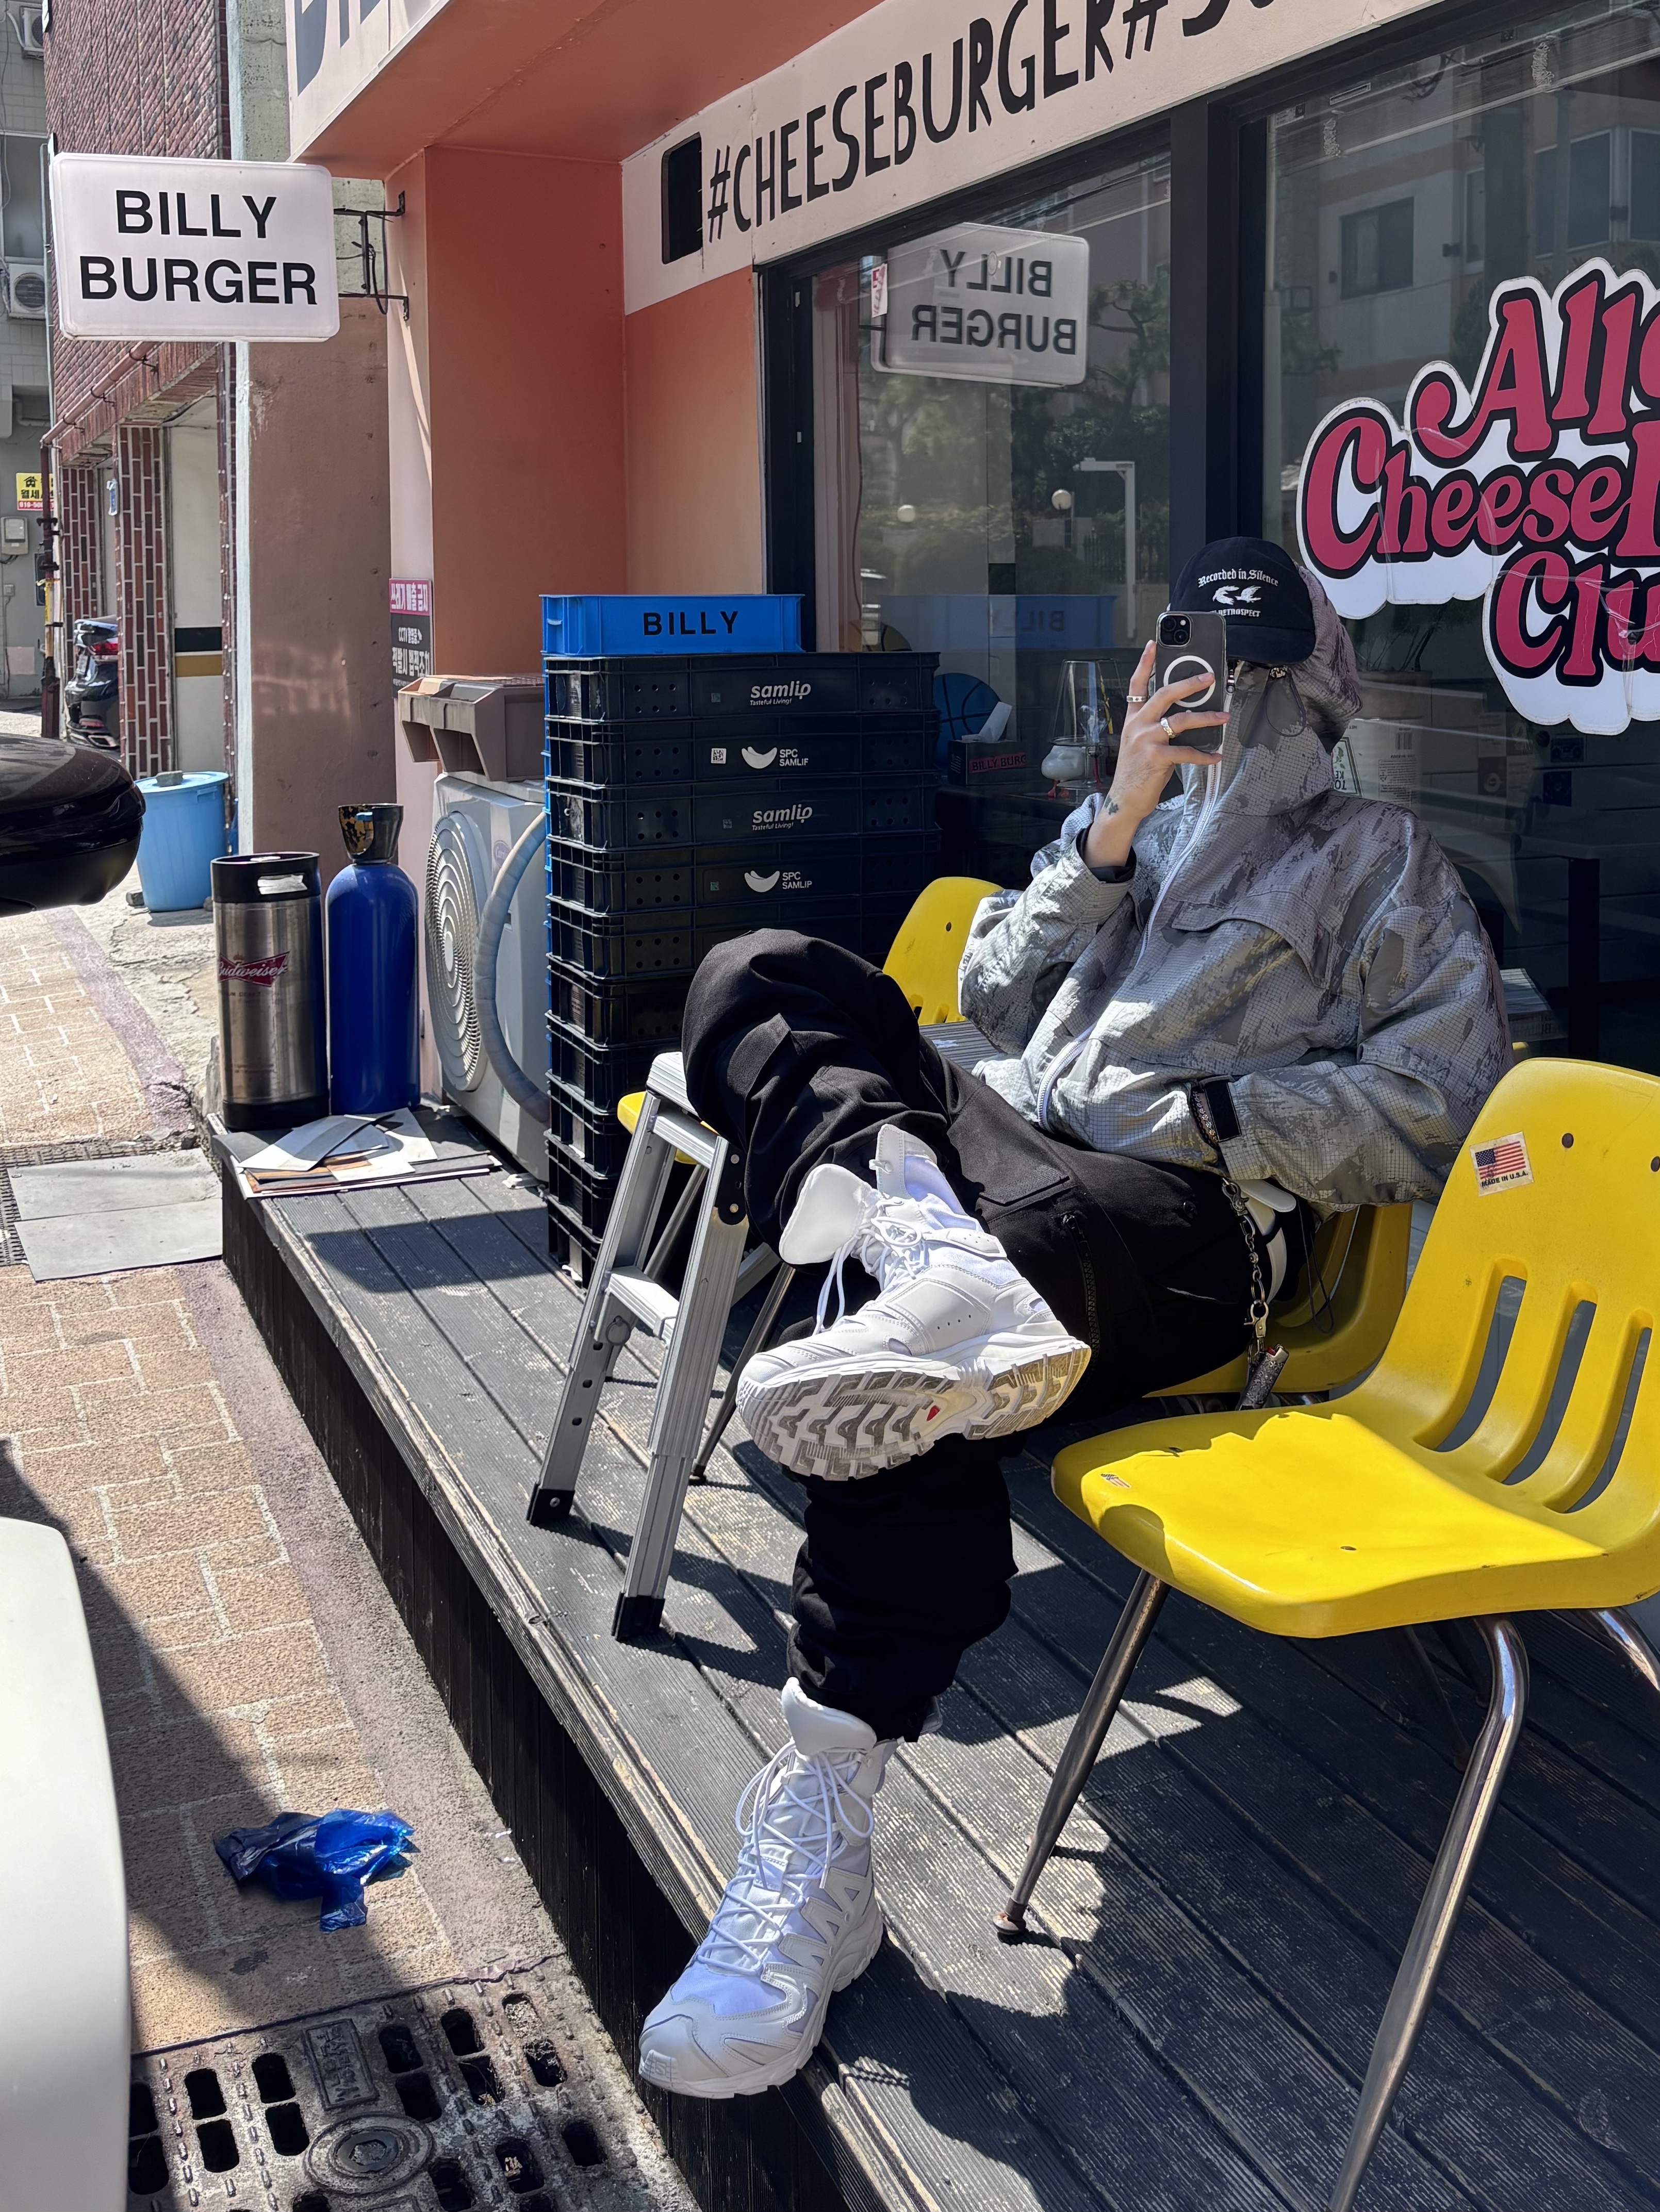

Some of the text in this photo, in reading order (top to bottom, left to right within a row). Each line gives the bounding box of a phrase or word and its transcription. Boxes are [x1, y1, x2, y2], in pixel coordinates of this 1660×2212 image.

[116, 190, 277, 239] BILLY
[79, 256, 318, 305] BURGER
[1197, 568, 1279, 588] Recorded in Silence
[643, 610, 738, 636] BILLY
[750, 680, 811, 700] samlip
[779, 748, 798, 758] SPC
[972, 758, 998, 771] BILLY
[752, 804, 813, 823] samlip
[752, 823, 774, 831] Tasteful
[782, 871, 801, 881] SPC
[782, 881, 813, 889] SAMLIP
[1481, 1177, 1500, 1187] MADE
[1509, 1170, 1528, 1180] U.S.A.
